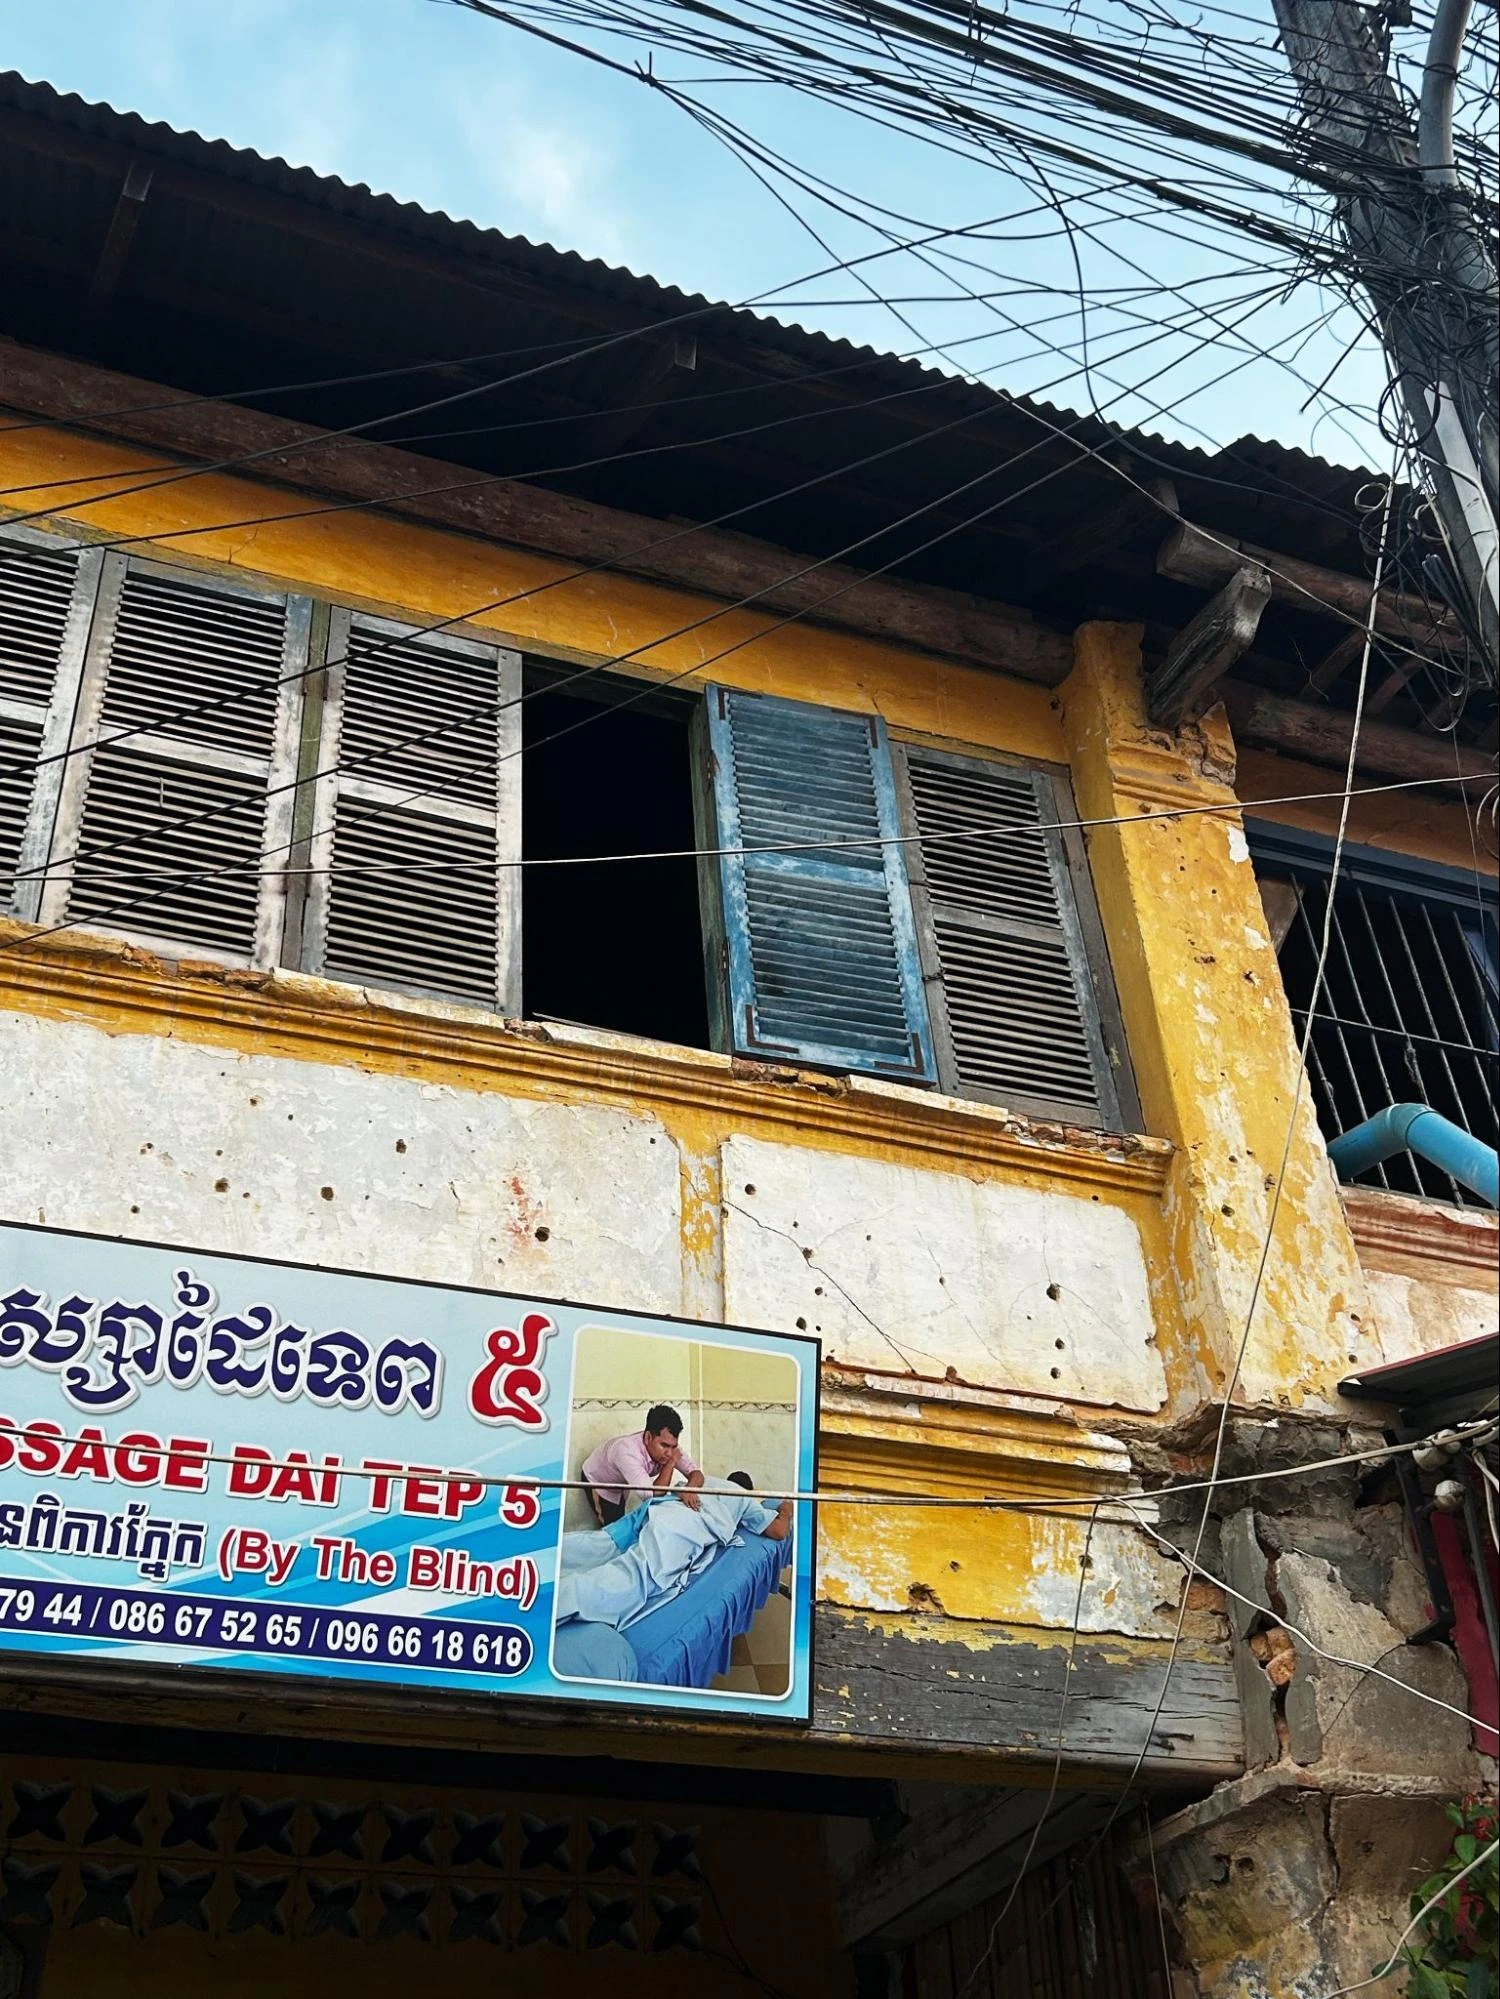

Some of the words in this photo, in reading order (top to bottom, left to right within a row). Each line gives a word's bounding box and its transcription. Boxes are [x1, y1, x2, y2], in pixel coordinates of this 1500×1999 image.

[472, 1314, 551, 1424] ៥
[229, 1446, 340, 1503] DAI
[363, 1461, 483, 1517] TEP
[502, 1476, 541, 1526] 5
[219, 1528, 298, 1581] (By
[313, 1538, 396, 1583] The
[410, 1547, 538, 1608] Blind)
[43, 1593, 83, 1626] 44
[109, 1599, 166, 1634] 086
[174, 1605, 213, 1638] 67
[220, 1610, 258, 1643] 52
[265, 1613, 302, 1647] 65
[326, 1619, 379, 1654] 096
[387, 1625, 422, 1657] 66
[431, 1629, 464, 1662] 18
[472, 1633, 522, 1667] 618
